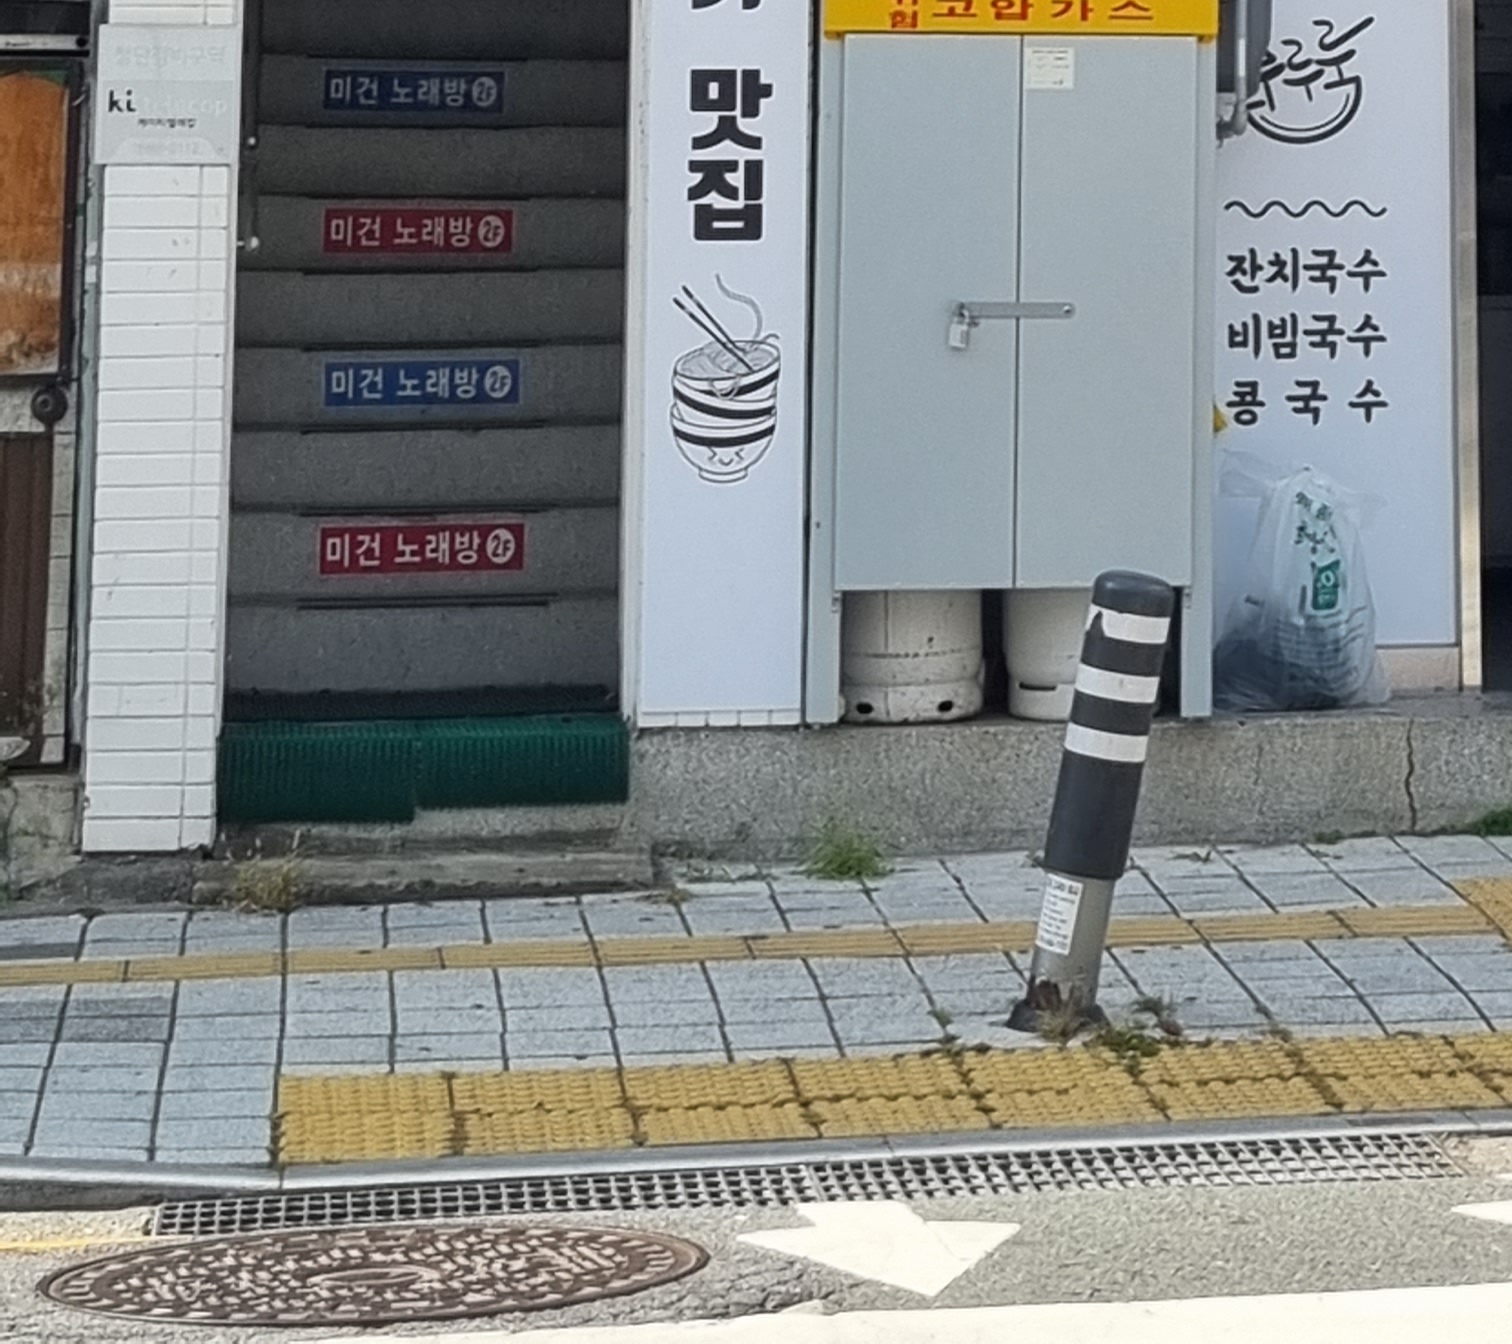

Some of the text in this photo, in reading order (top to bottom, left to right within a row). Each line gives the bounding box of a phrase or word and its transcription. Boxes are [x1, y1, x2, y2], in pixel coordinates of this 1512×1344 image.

[329, 76, 379, 106] 미건
[390, 75, 471, 107] 노래방
[687, 67, 775, 242] 맛집
[330, 216, 382, 248] 미건
[393, 215, 473, 248] 노래방
[1225, 247, 1388, 295] 잔치국수
[1225, 313, 1388, 361] 비빔국수
[330, 368, 384, 400] 미건
[396, 367, 480, 400] 노래방
[1224, 378, 1389, 427] 콩국수
[326, 534, 382, 568] 미건
[393, 532, 481, 566] 노래방
